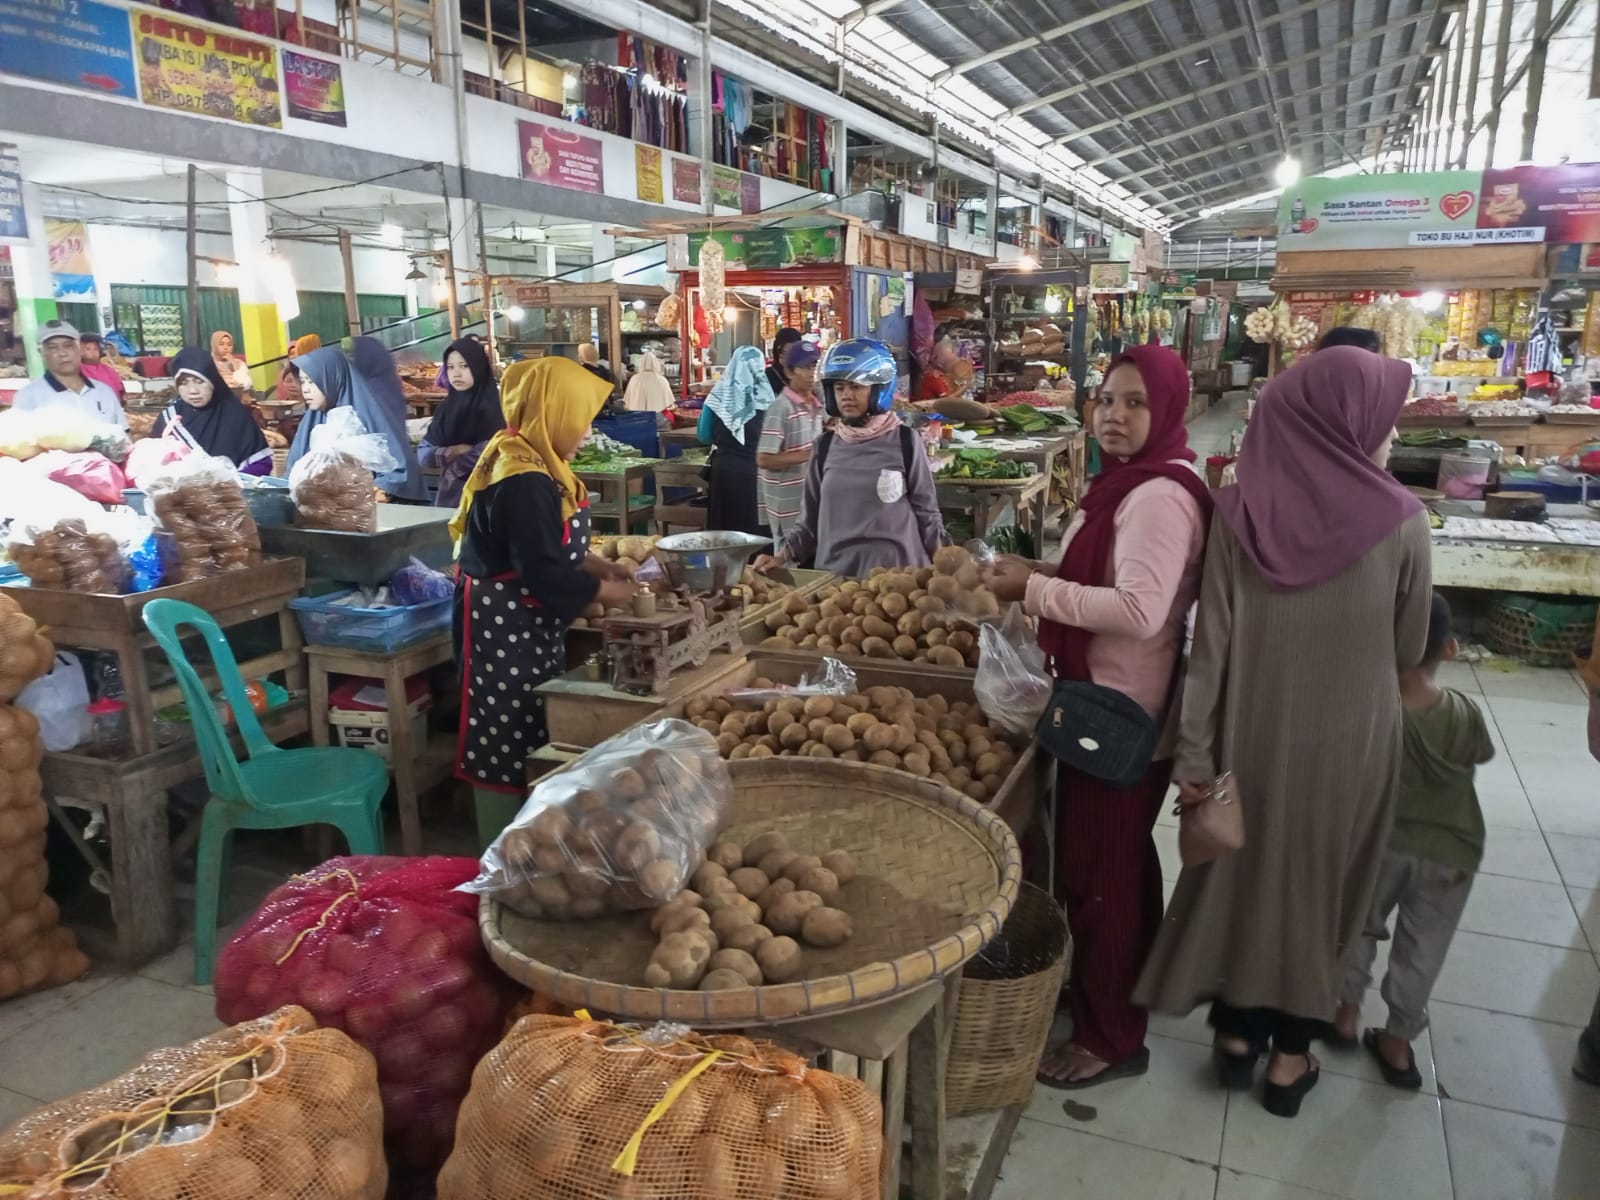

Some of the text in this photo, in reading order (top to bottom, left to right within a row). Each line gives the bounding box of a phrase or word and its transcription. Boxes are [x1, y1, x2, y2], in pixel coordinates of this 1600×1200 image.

[69, 1, 78, 15] 2
[1323, 197, 1430, 210] Sasa Santan Omega 3
[1417, 232, 1439, 242] TOKO
[1440, 231, 1452, 241] BU
[1454, 230, 1473, 241] HAJI
[1475, 230, 1494, 240] NUR
